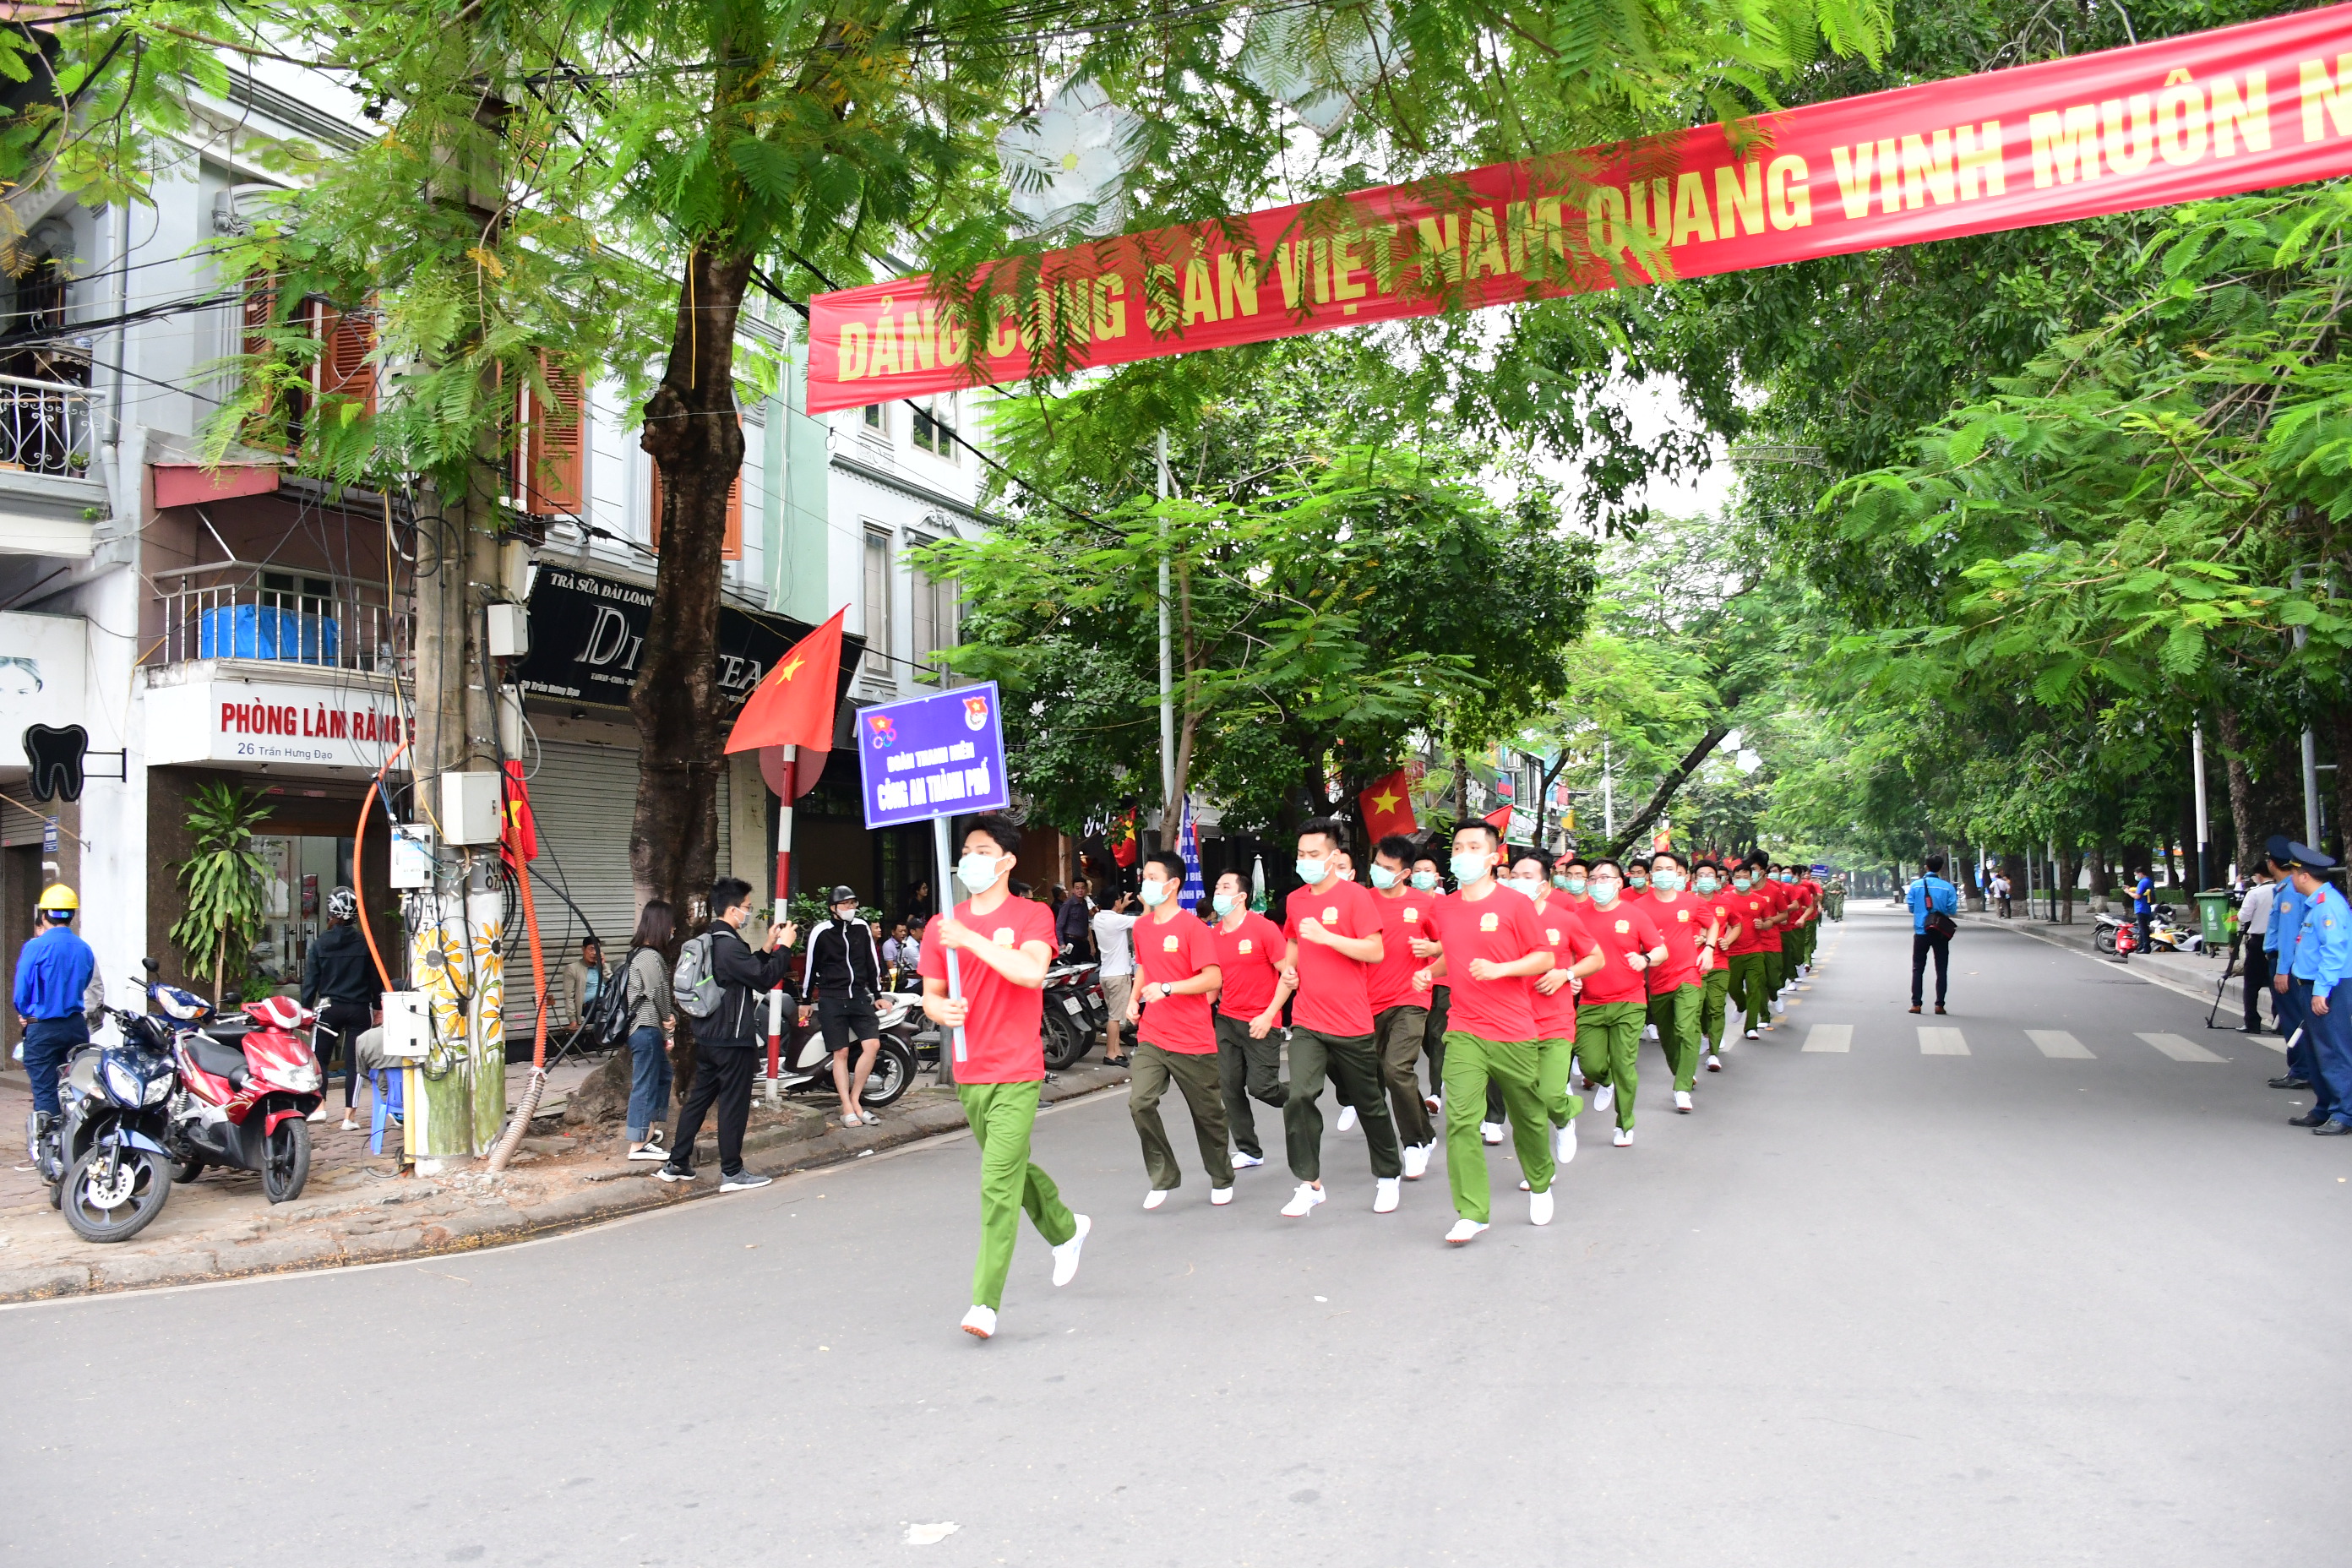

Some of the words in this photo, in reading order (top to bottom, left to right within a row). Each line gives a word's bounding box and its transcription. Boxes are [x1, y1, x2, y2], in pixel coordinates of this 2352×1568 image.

[838, 296, 968, 382] ĐẢNG
[1145, 237, 1259, 331] SẢN
[1278, 217, 1398, 315] VIỆT
[1418, 195, 1565, 286] NAM
[1586, 155, 1812, 264] QUANG
[1831, 120, 2006, 220] VINH
[2029, 68, 2272, 189] MUÔN
[551, 572, 574, 590] TRÀ
[576, 578, 599, 595] SỮA
[601, 583, 623, 600] ĐÀI
[623, 590, 655, 607] LOAN
[220, 697, 297, 736] PHÒNG
[303, 702, 346, 738] LÀM
[353, 706, 400, 743] RĂNG
[237, 743, 254, 755] 26
[285, 748, 311, 760] Hưng
[314, 749, 333, 760] Đạo
[878, 777, 909, 811] CÔNG
[910, 777, 927, 806] AN
